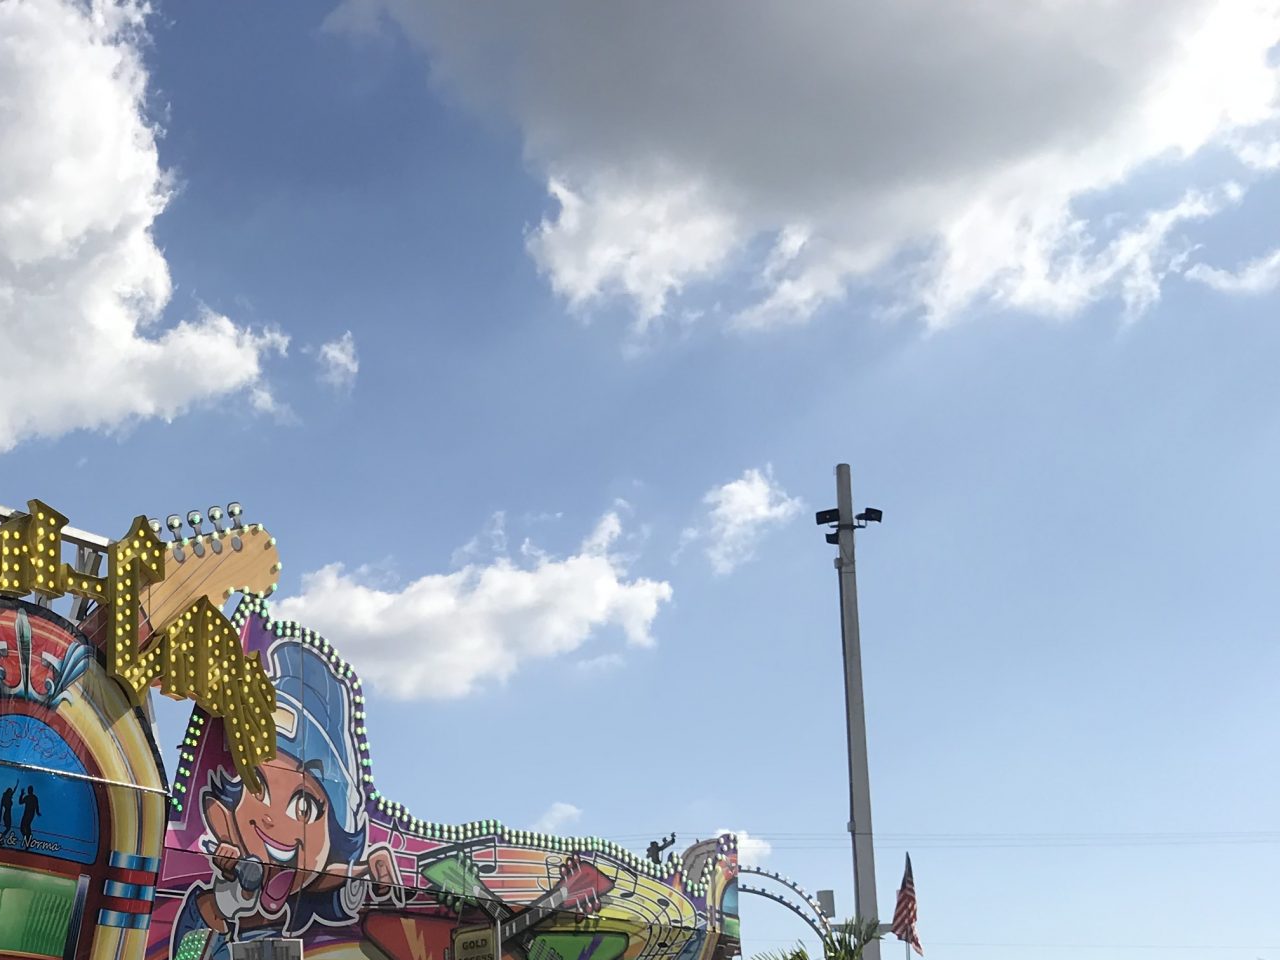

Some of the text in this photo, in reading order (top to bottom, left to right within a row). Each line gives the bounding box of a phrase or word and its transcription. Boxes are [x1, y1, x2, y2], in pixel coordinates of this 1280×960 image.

[6, 833, 17, 846] &
[21, 835, 61, 851] Norma
[462, 938, 488, 950] GOLD
